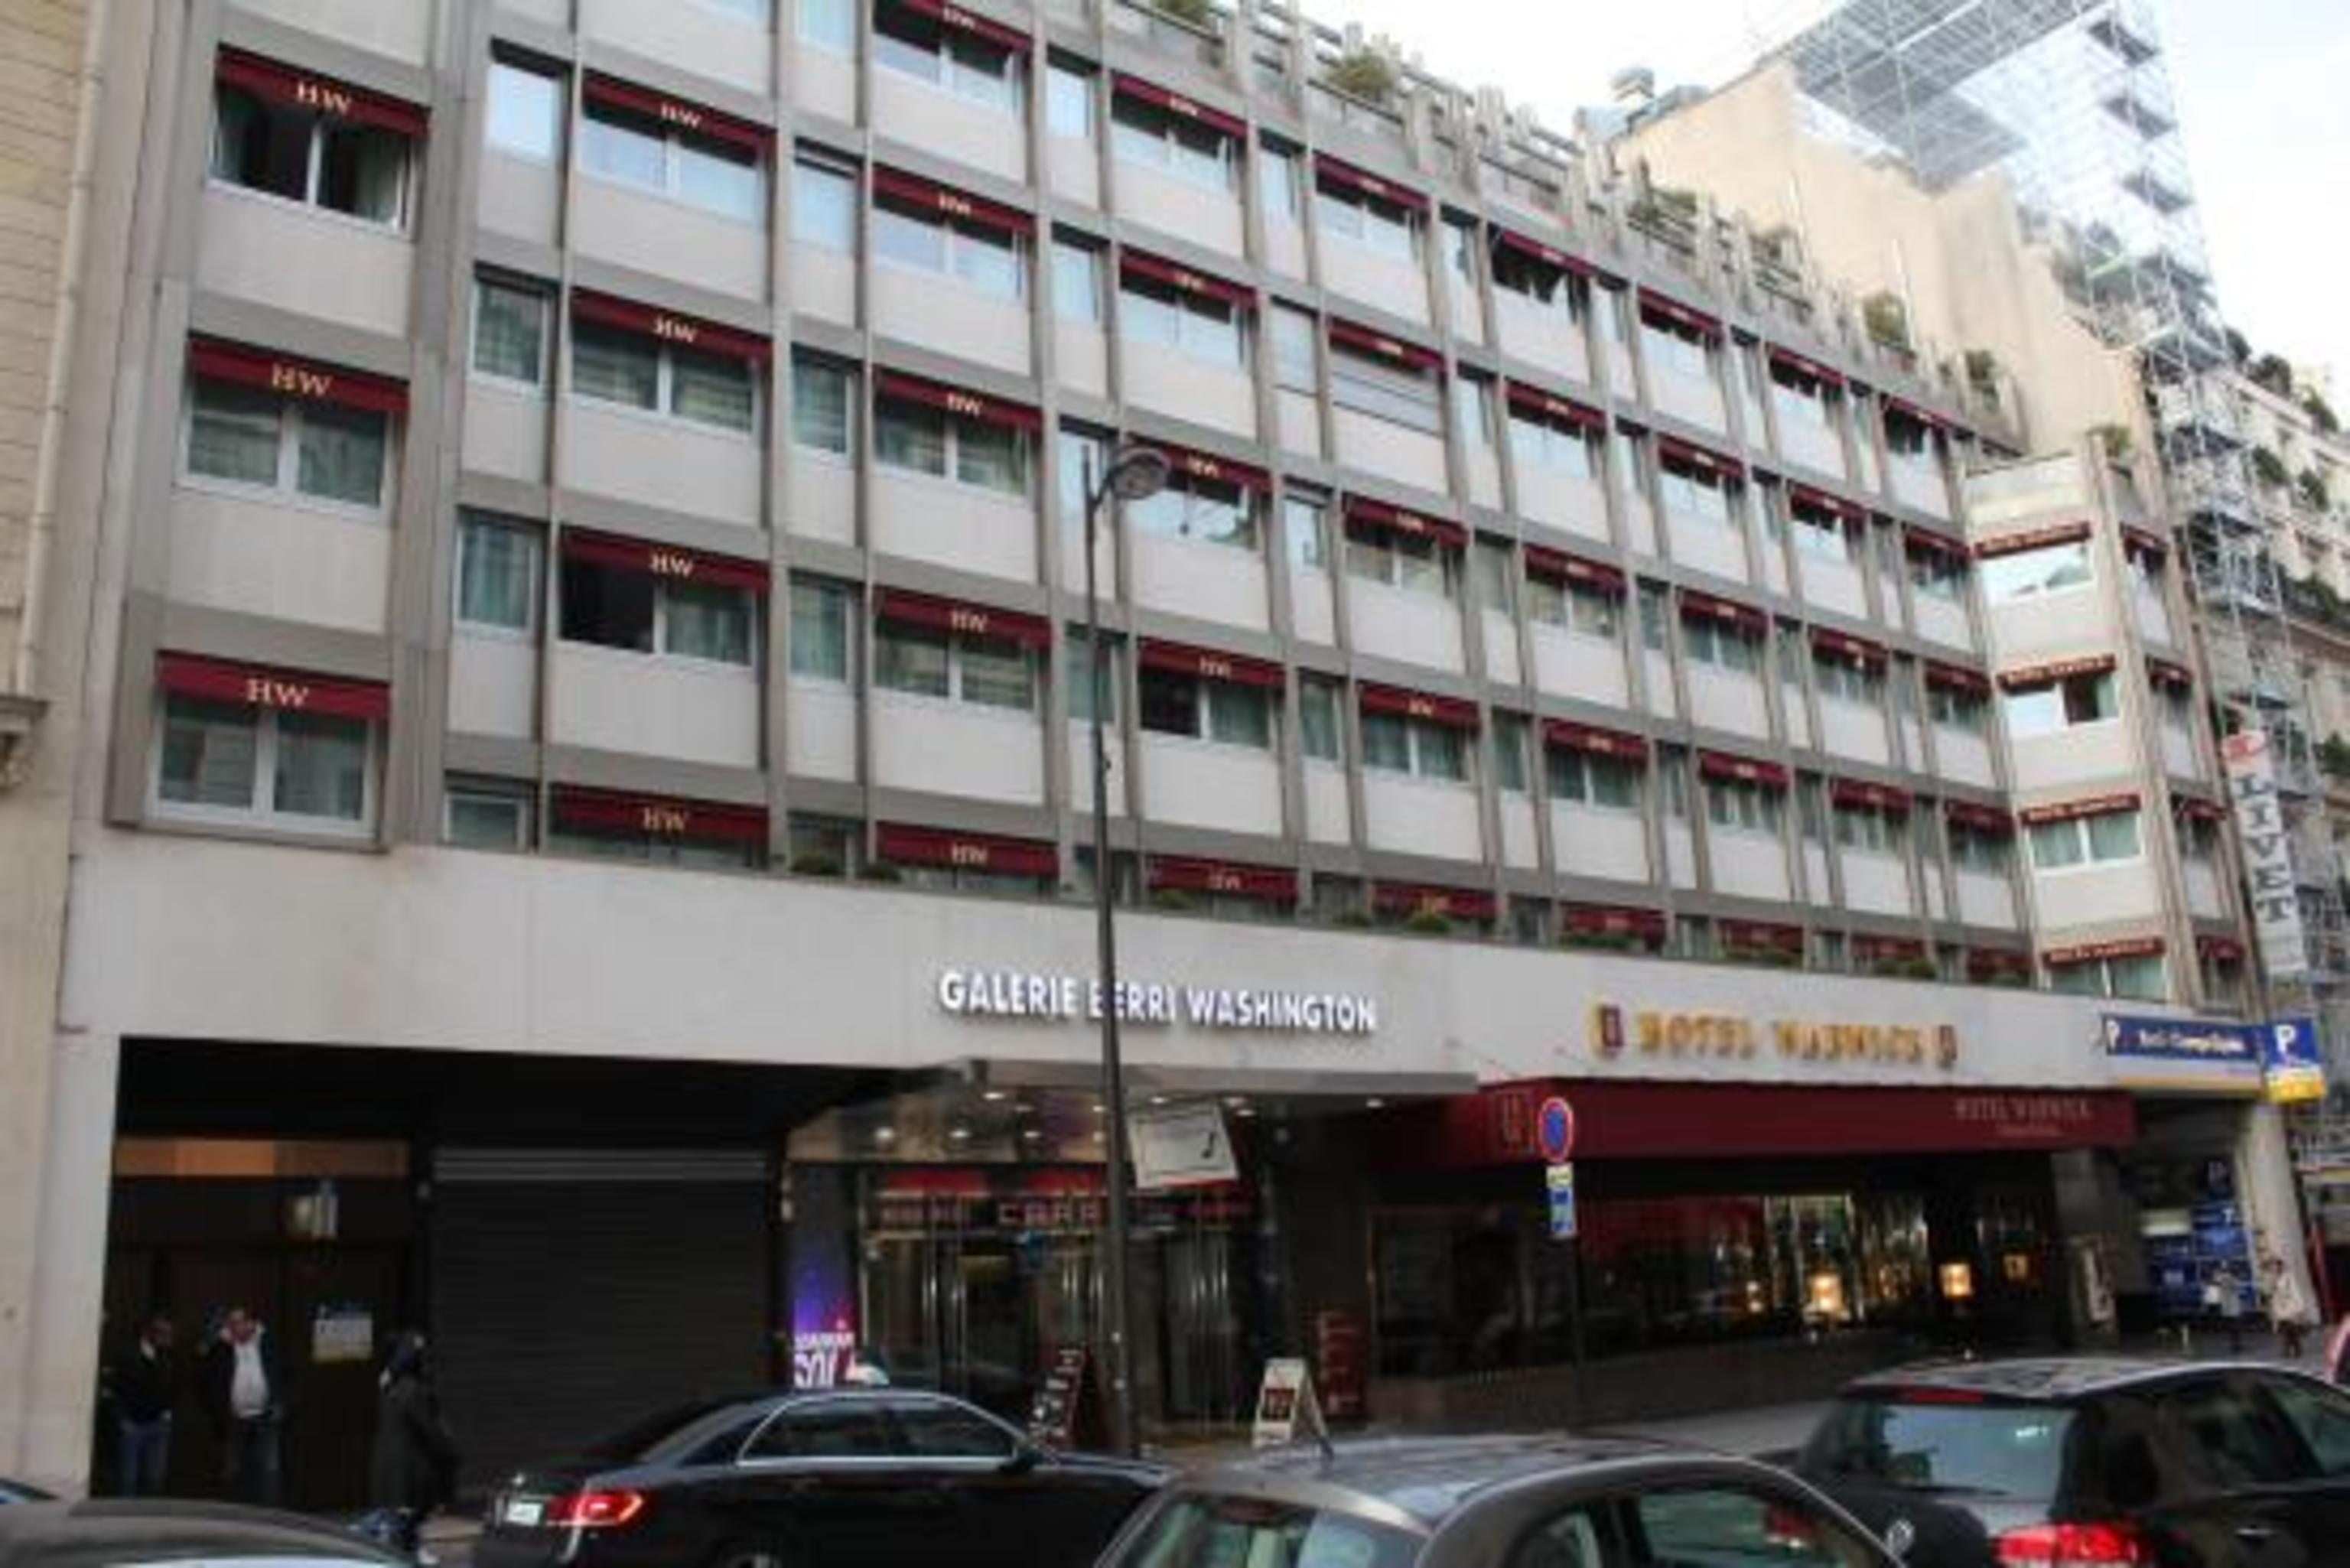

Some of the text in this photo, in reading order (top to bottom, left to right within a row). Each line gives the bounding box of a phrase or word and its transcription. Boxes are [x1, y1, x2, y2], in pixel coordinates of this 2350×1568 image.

[298, 80, 352, 113] HW
[661, 102, 702, 128] HW
[653, 314, 698, 343] HW
[271, 363, 334, 395] HW
[650, 551, 694, 577] HW
[246, 677, 310, 707] HW
[643, 805, 688, 831] HW
[939, 971, 1077, 1017] GALERIE
[1186, 987, 1376, 1033] WASHINGTON
[2274, 1023, 2297, 1053] P
